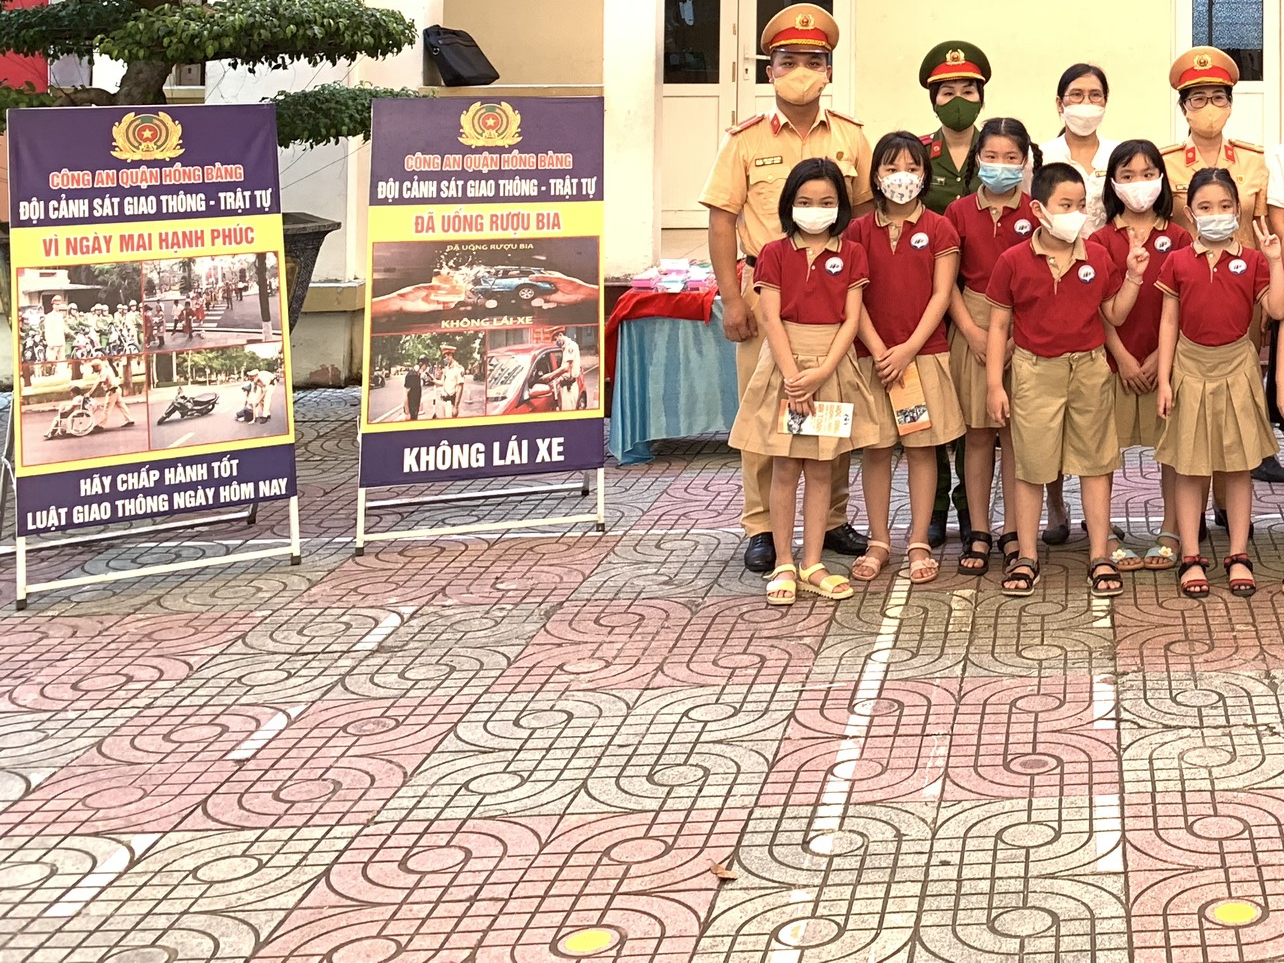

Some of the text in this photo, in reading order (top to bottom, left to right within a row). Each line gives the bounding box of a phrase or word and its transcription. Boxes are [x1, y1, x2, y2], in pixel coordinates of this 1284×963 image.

[50, 169, 91, 189] CÔNG
[94, 170, 117, 187] AN
[119, 166, 159, 189] QUẬN
[205, 163, 243, 182] BÀNG
[404, 152, 440, 171] CÔNG
[442, 154, 462, 171] AN
[464, 151, 499, 173] QUẬN
[538, 150, 573, 170] BÀNG
[377, 178, 399, 202] ĐỘI
[402, 175, 437, 198] CẢNH
[440, 177, 463, 198] SÁT
[466, 180, 495, 197] GIAO
[498, 176, 538, 197] THÔNG
[549, 175, 578, 199] TRẬT
[581, 176, 597, 198] TỰ
[19, 197, 44, 224] ĐỘI
[49, 194, 89, 219] CẢNH
[93, 194, 120, 217] SÁT
[124, 196, 156, 215] GIAO
[160, 191, 205, 213] THÔNG
[218, 188, 250, 216] TRẬT
[254, 188, 272, 211] TỰ
[415, 207, 561, 236] ĐÃ UỐNG RƯỢU BIA
[42, 224, 255, 257] VÌ NGÀY MAI HẠNH PHÚC
[403, 435, 565, 473] KHÔNG LÁI XE
[80, 454, 239, 496] HÃY CHẤP HÀNH TỐT
[27, 478, 288, 530] LUẬT GIAO THÔNG NGÀY HÔM NAY
